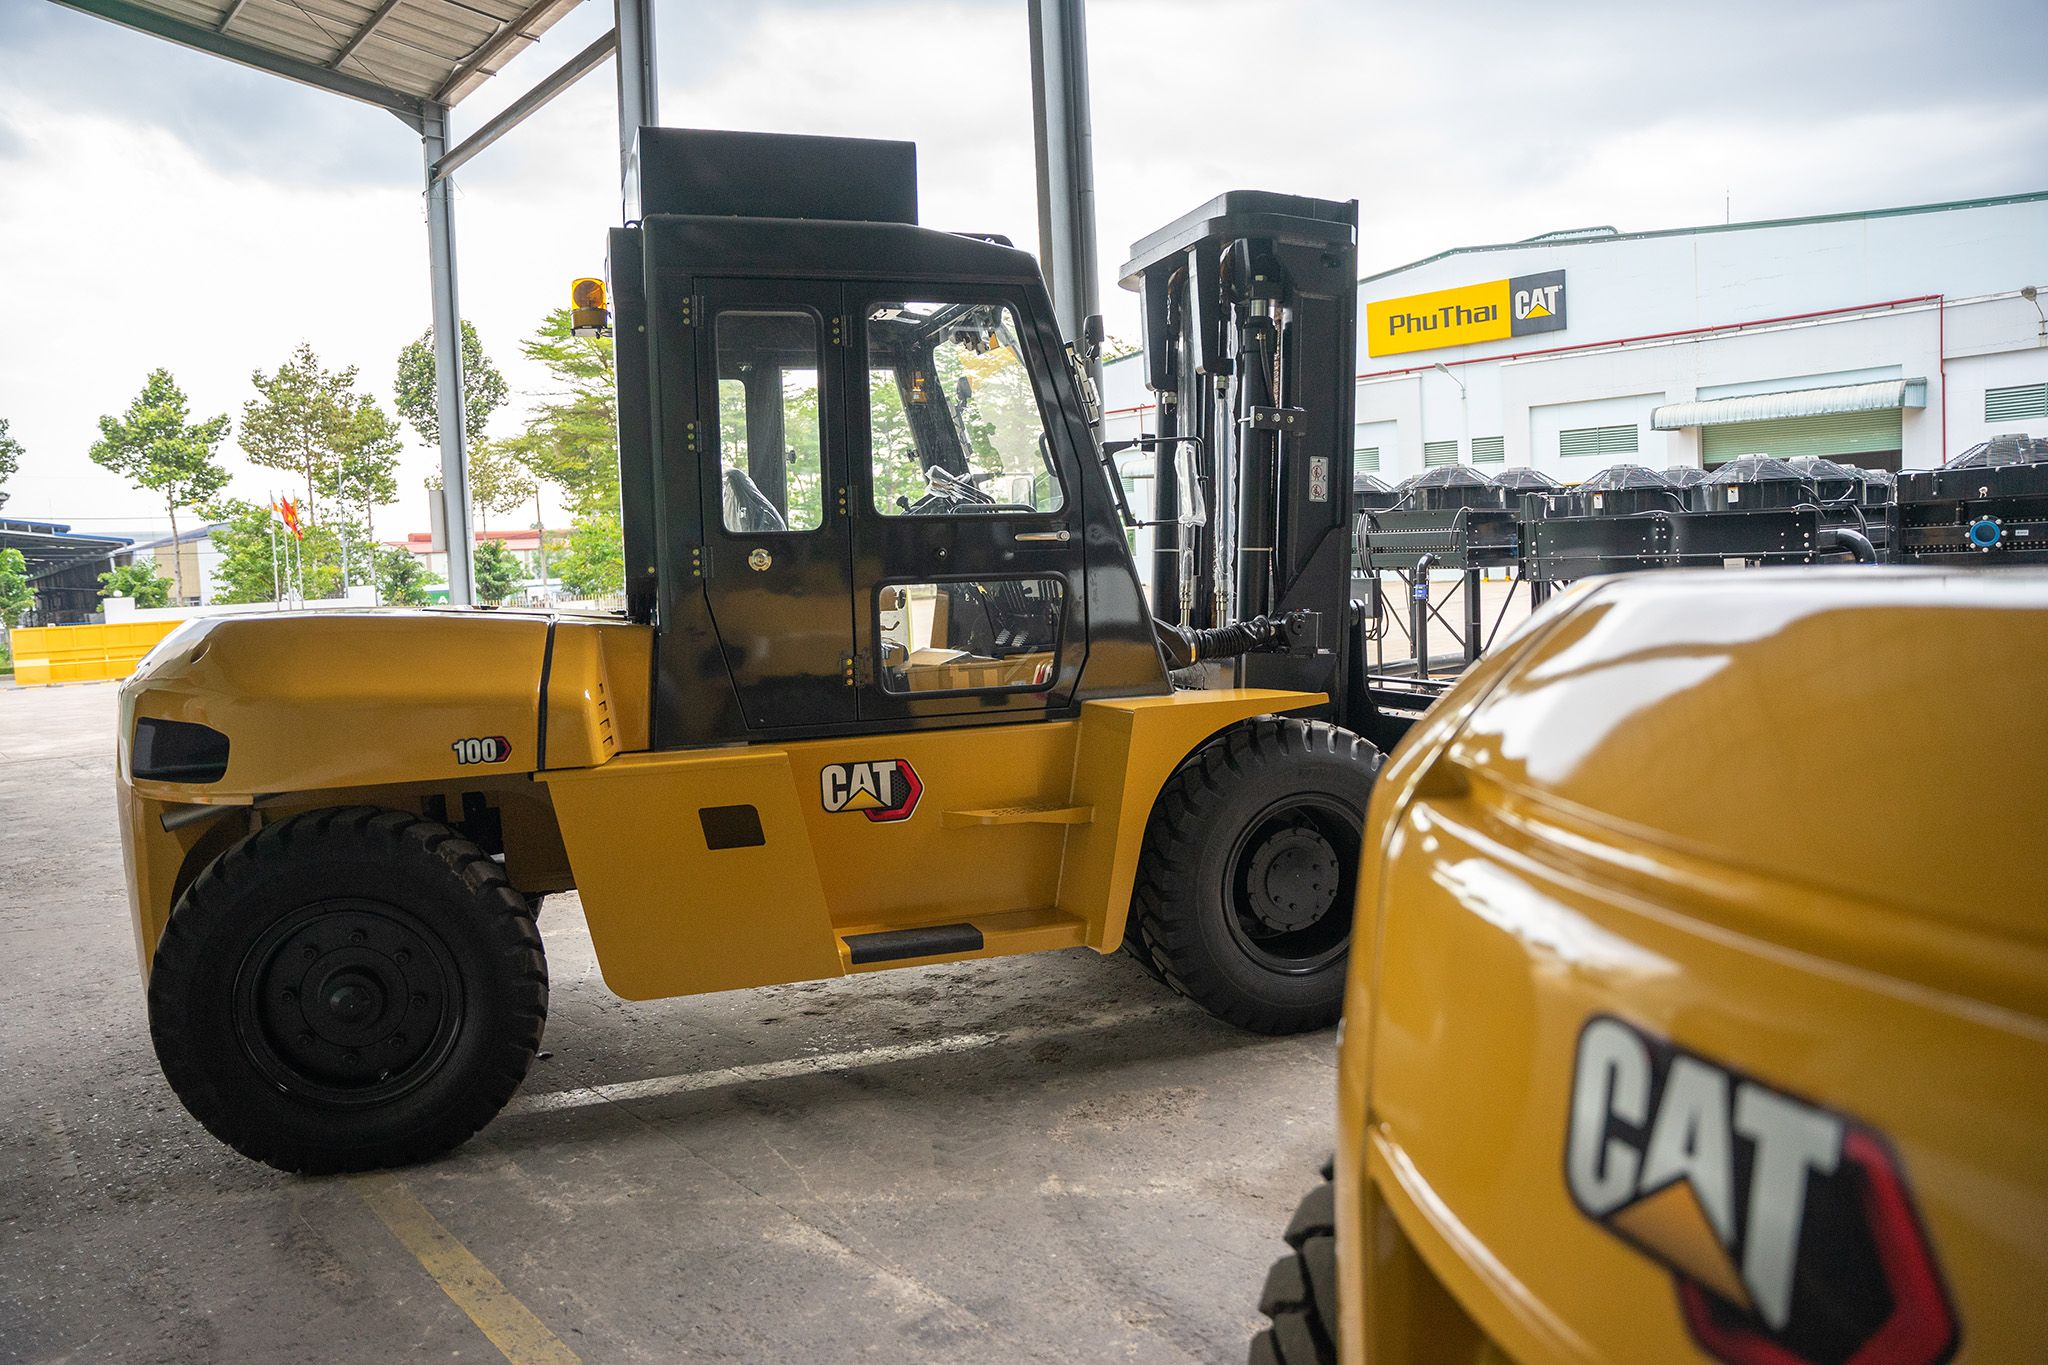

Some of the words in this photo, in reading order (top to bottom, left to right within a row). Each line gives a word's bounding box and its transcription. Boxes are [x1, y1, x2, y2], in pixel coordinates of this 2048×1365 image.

[1389, 304, 1498, 336] PhuThai
[1514, 285, 1560, 320] CAT
[453, 738, 497, 764] 100
[821, 761, 897, 812] CAT
[1567, 1015, 1844, 1330] CAT
